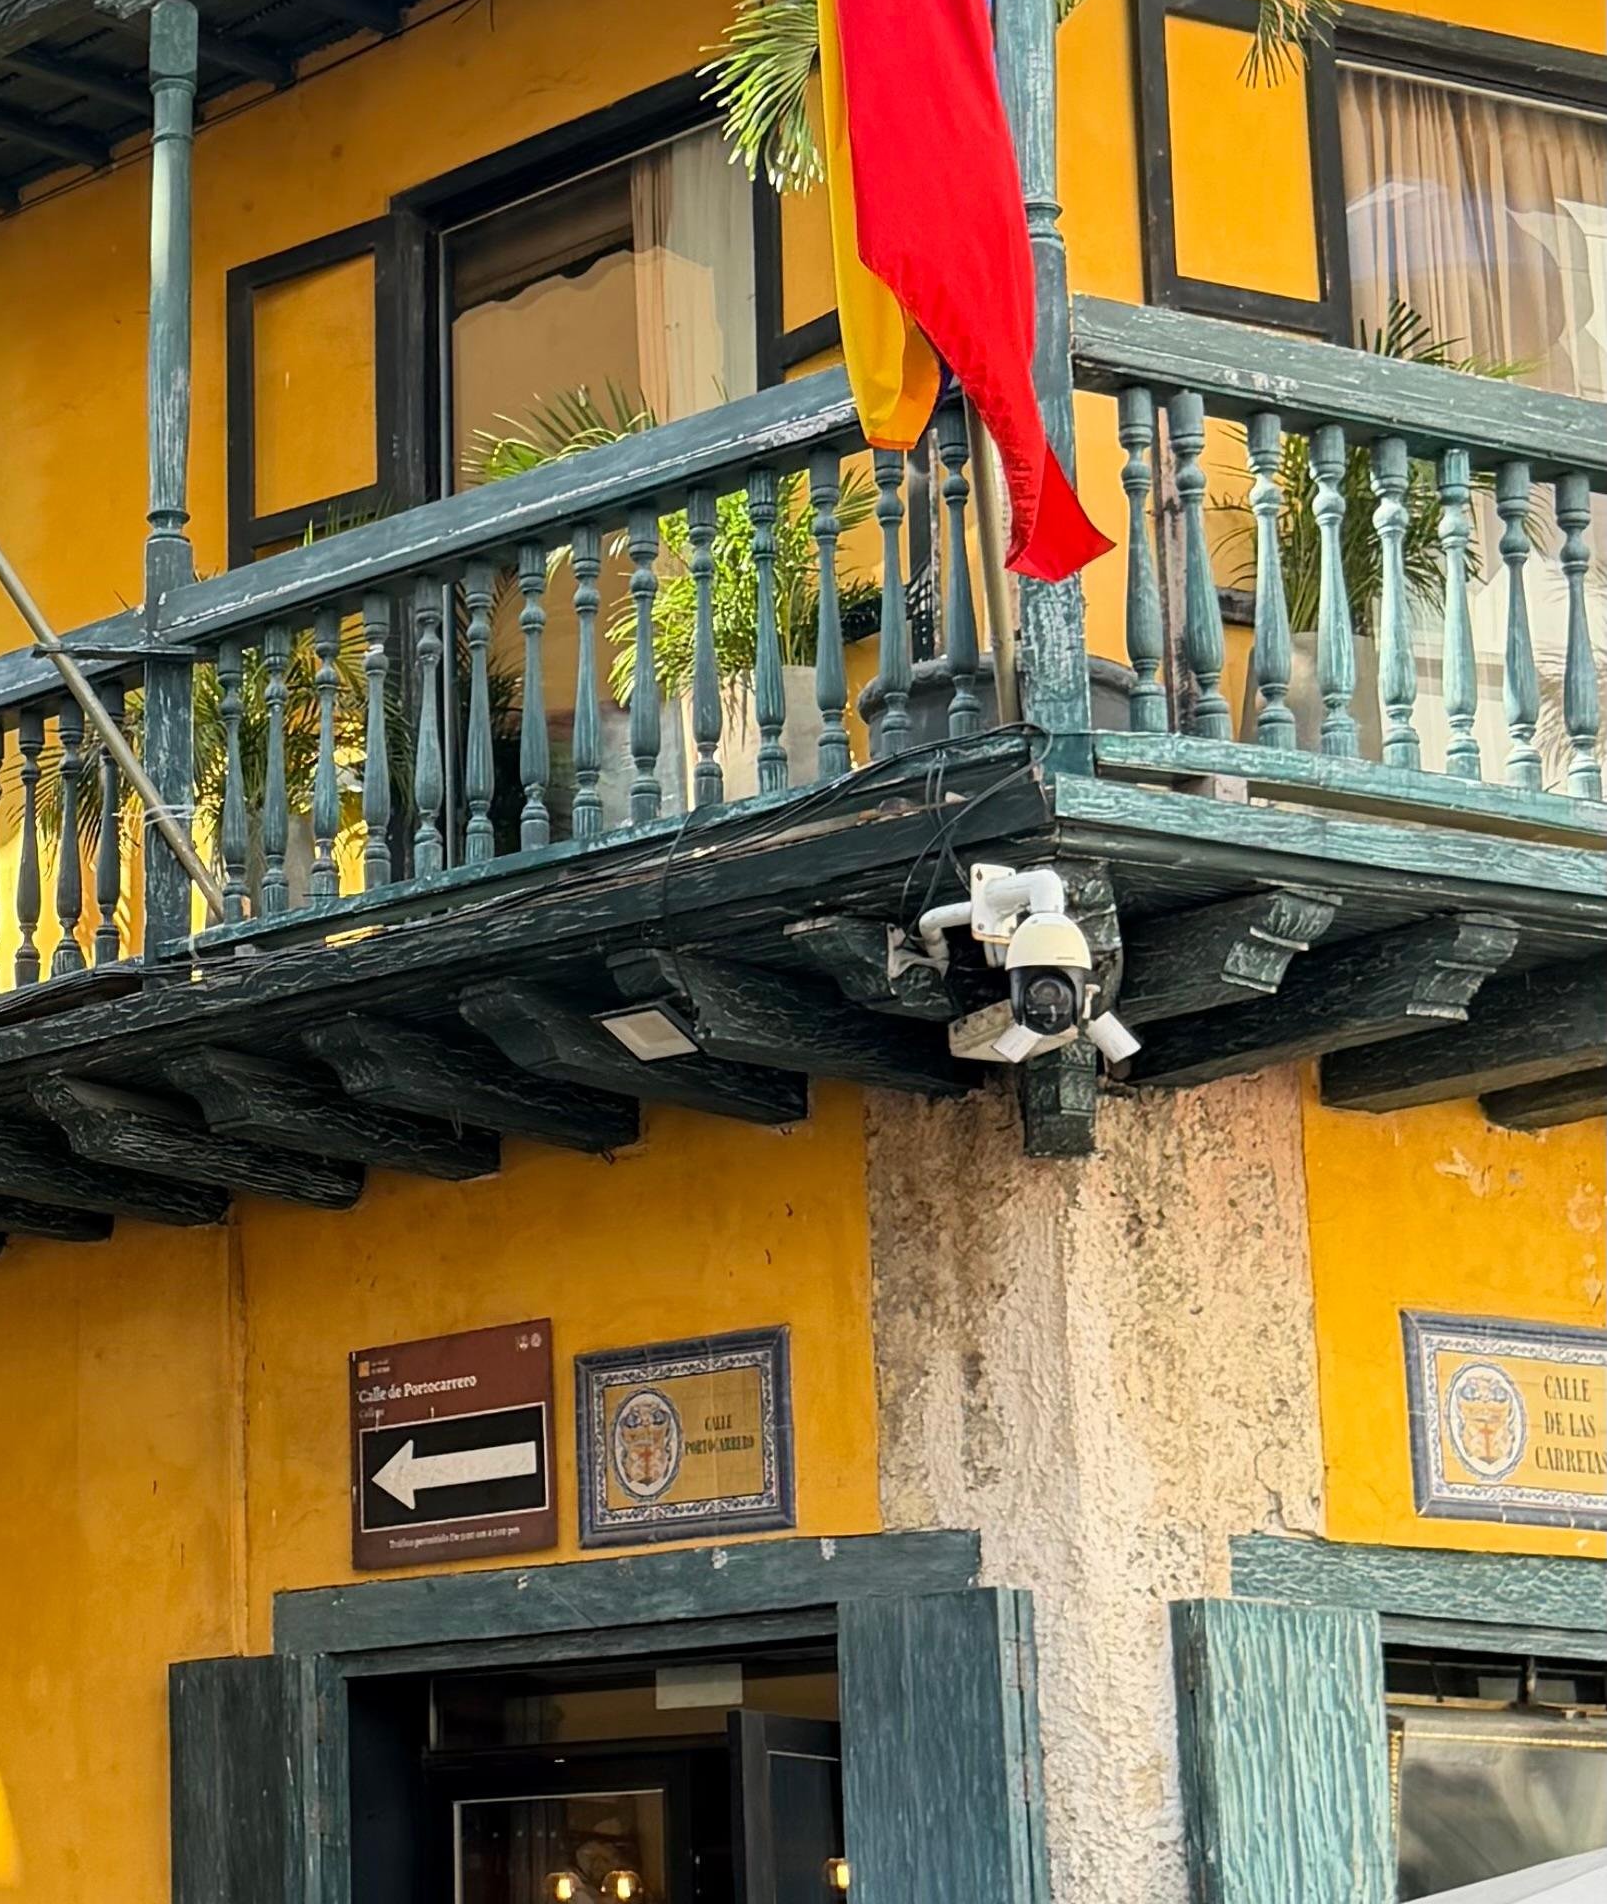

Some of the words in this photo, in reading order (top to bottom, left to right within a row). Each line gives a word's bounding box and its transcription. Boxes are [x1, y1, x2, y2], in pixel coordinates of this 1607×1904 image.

[359, 1385, 386, 1403] Calle
[387, 1384, 402, 1400] de
[404, 1376, 477, 1397] Portocarrero
[1544, 1375, 1591, 1402] CALLE
[705, 1414, 732, 1431] CALLE
[1544, 1410, 1564, 1436] DE
[1569, 1413, 1596, 1438] LAS
